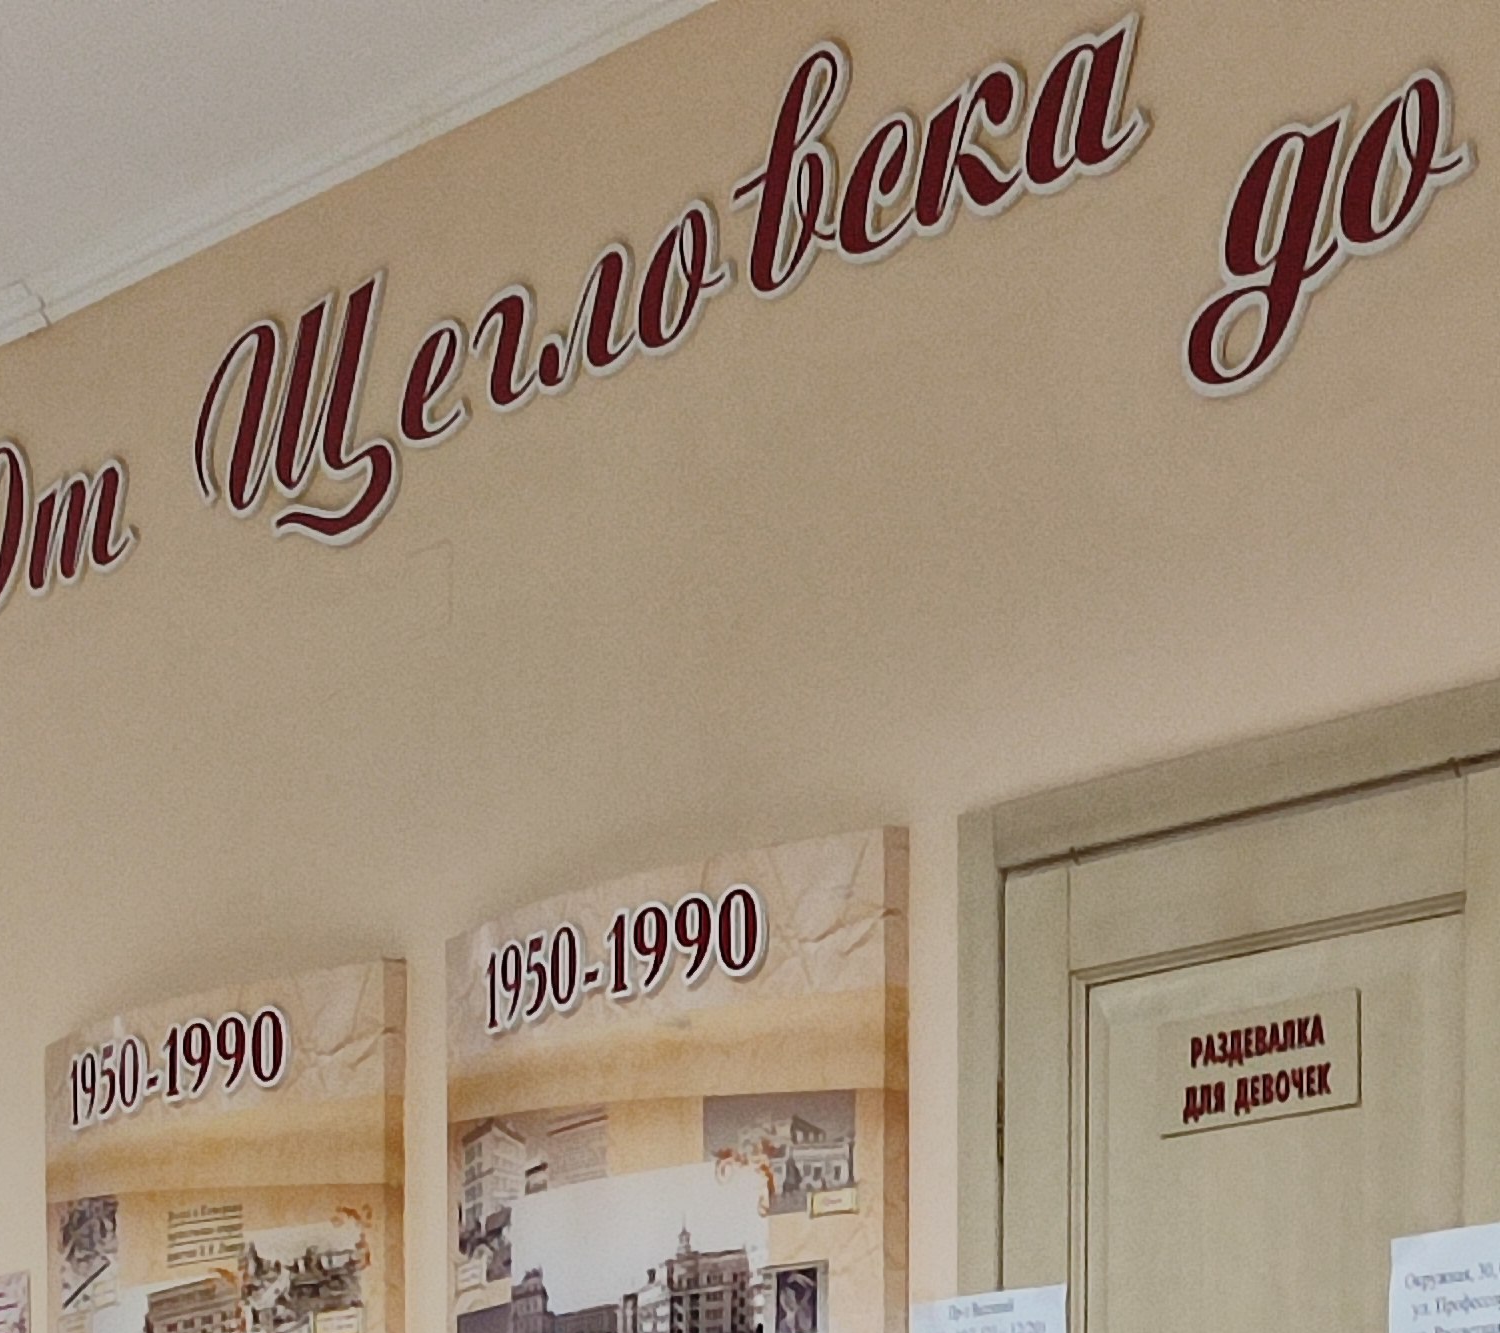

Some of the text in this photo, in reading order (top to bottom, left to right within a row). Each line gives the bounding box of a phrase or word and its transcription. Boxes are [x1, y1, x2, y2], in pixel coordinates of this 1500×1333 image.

[195, 24, 1148, 538] Щегловска
[1186, 72, 1466, 388] до
[486, 887, 760, 1030] 1950-1990
[70, 1009, 284, 1127] 1950-1990
[1183, 1062, 1332, 1124] ДЛЯ ДЕВОЧЕК
[1191, 1014, 1325, 1068] РАЗДЕВАЛКА
